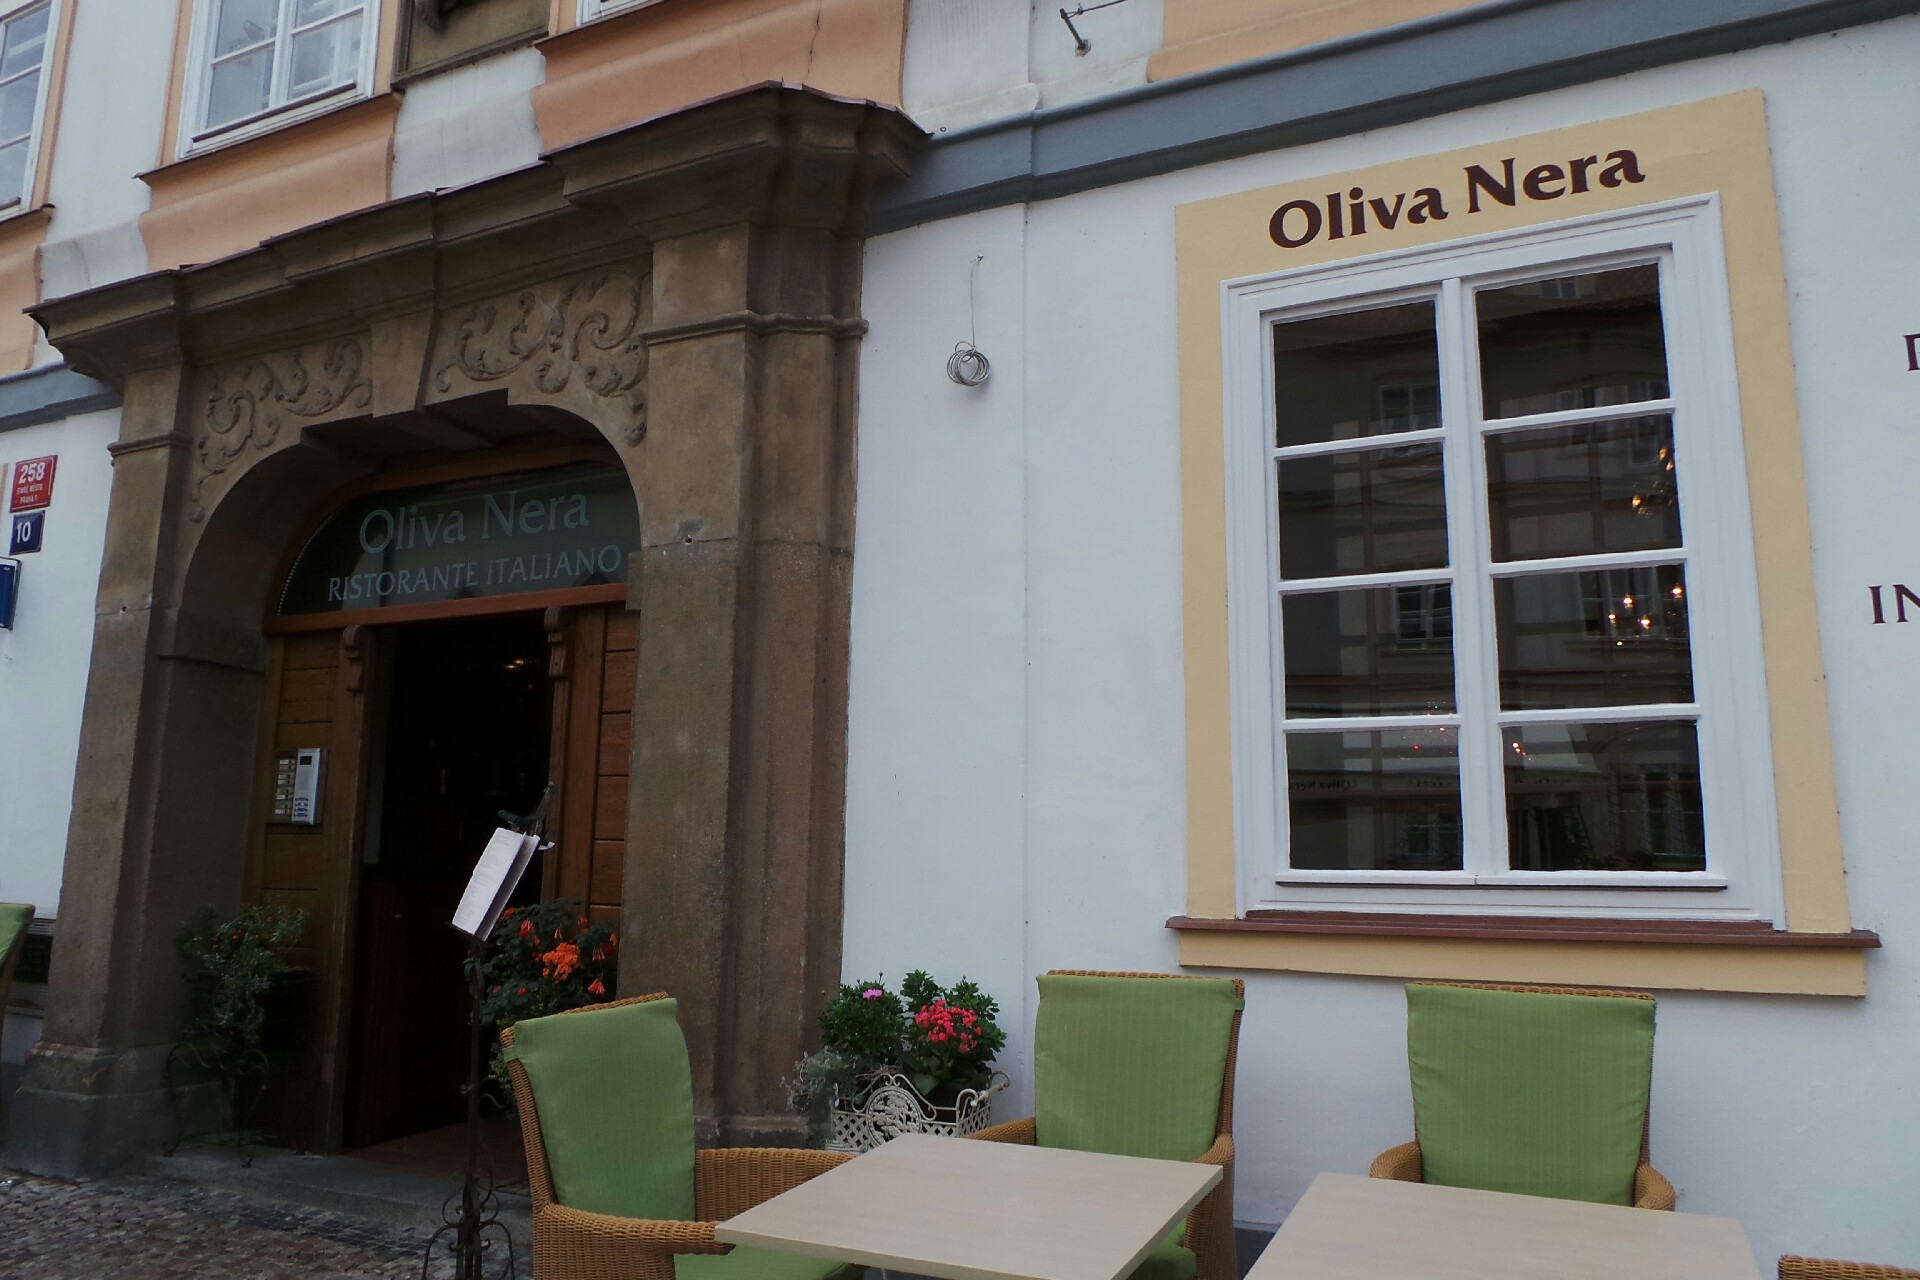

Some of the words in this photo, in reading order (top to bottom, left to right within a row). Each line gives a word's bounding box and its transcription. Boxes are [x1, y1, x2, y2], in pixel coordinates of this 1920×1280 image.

[1268, 186, 1449, 249] Oliva
[1463, 148, 1646, 215] Nera
[18, 462, 46, 484] 258
[16, 521, 32, 544] 10
[359, 506, 466, 554] Oliva
[480, 491, 590, 539] Nera
[327, 561, 479, 602] RISTORANTE
[486, 544, 622, 586] ITALIANO
